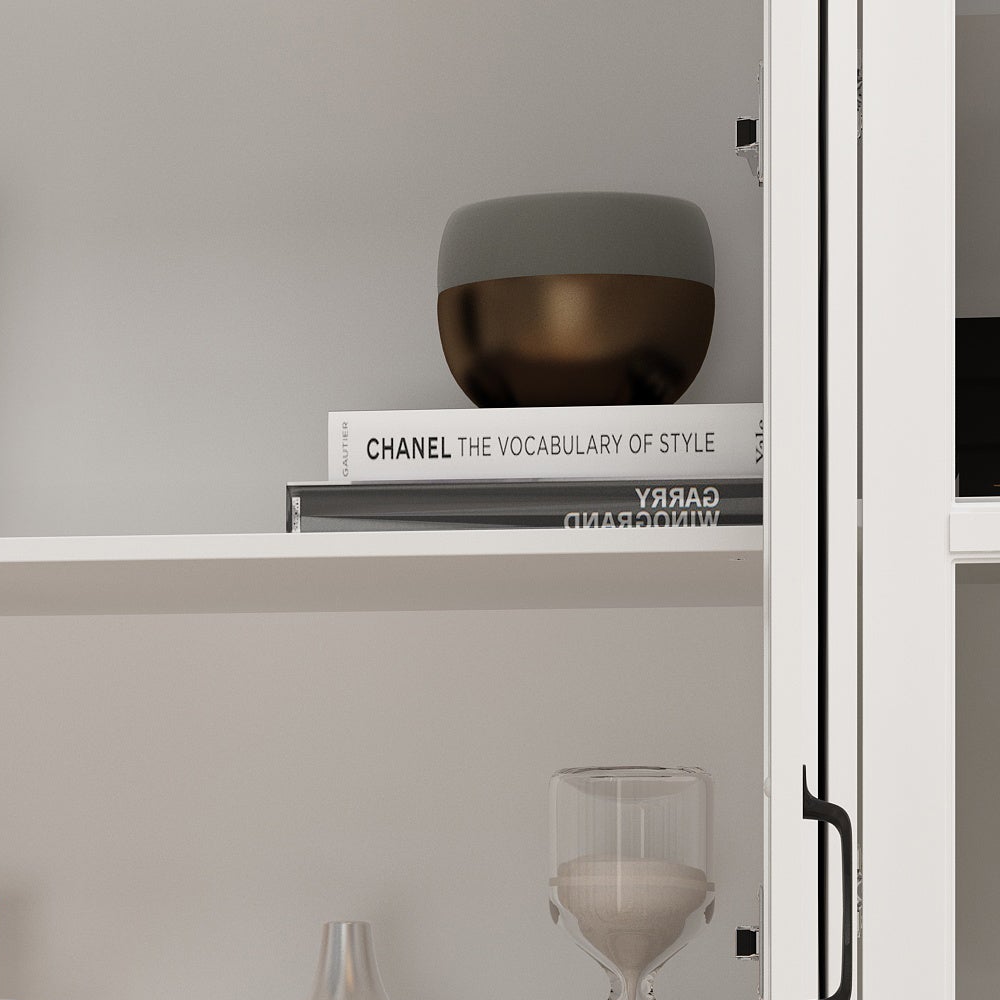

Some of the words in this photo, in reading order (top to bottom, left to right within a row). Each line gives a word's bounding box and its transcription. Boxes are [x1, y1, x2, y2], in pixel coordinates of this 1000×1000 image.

[341, 421, 350, 478] GAUTIER
[366, 436, 452, 461] CHANEL
[457, 436, 492, 458] THE
[497, 432, 623, 457] VOCABULARY
[629, 433, 654, 455] OF
[659, 431, 716, 454] STYLE
